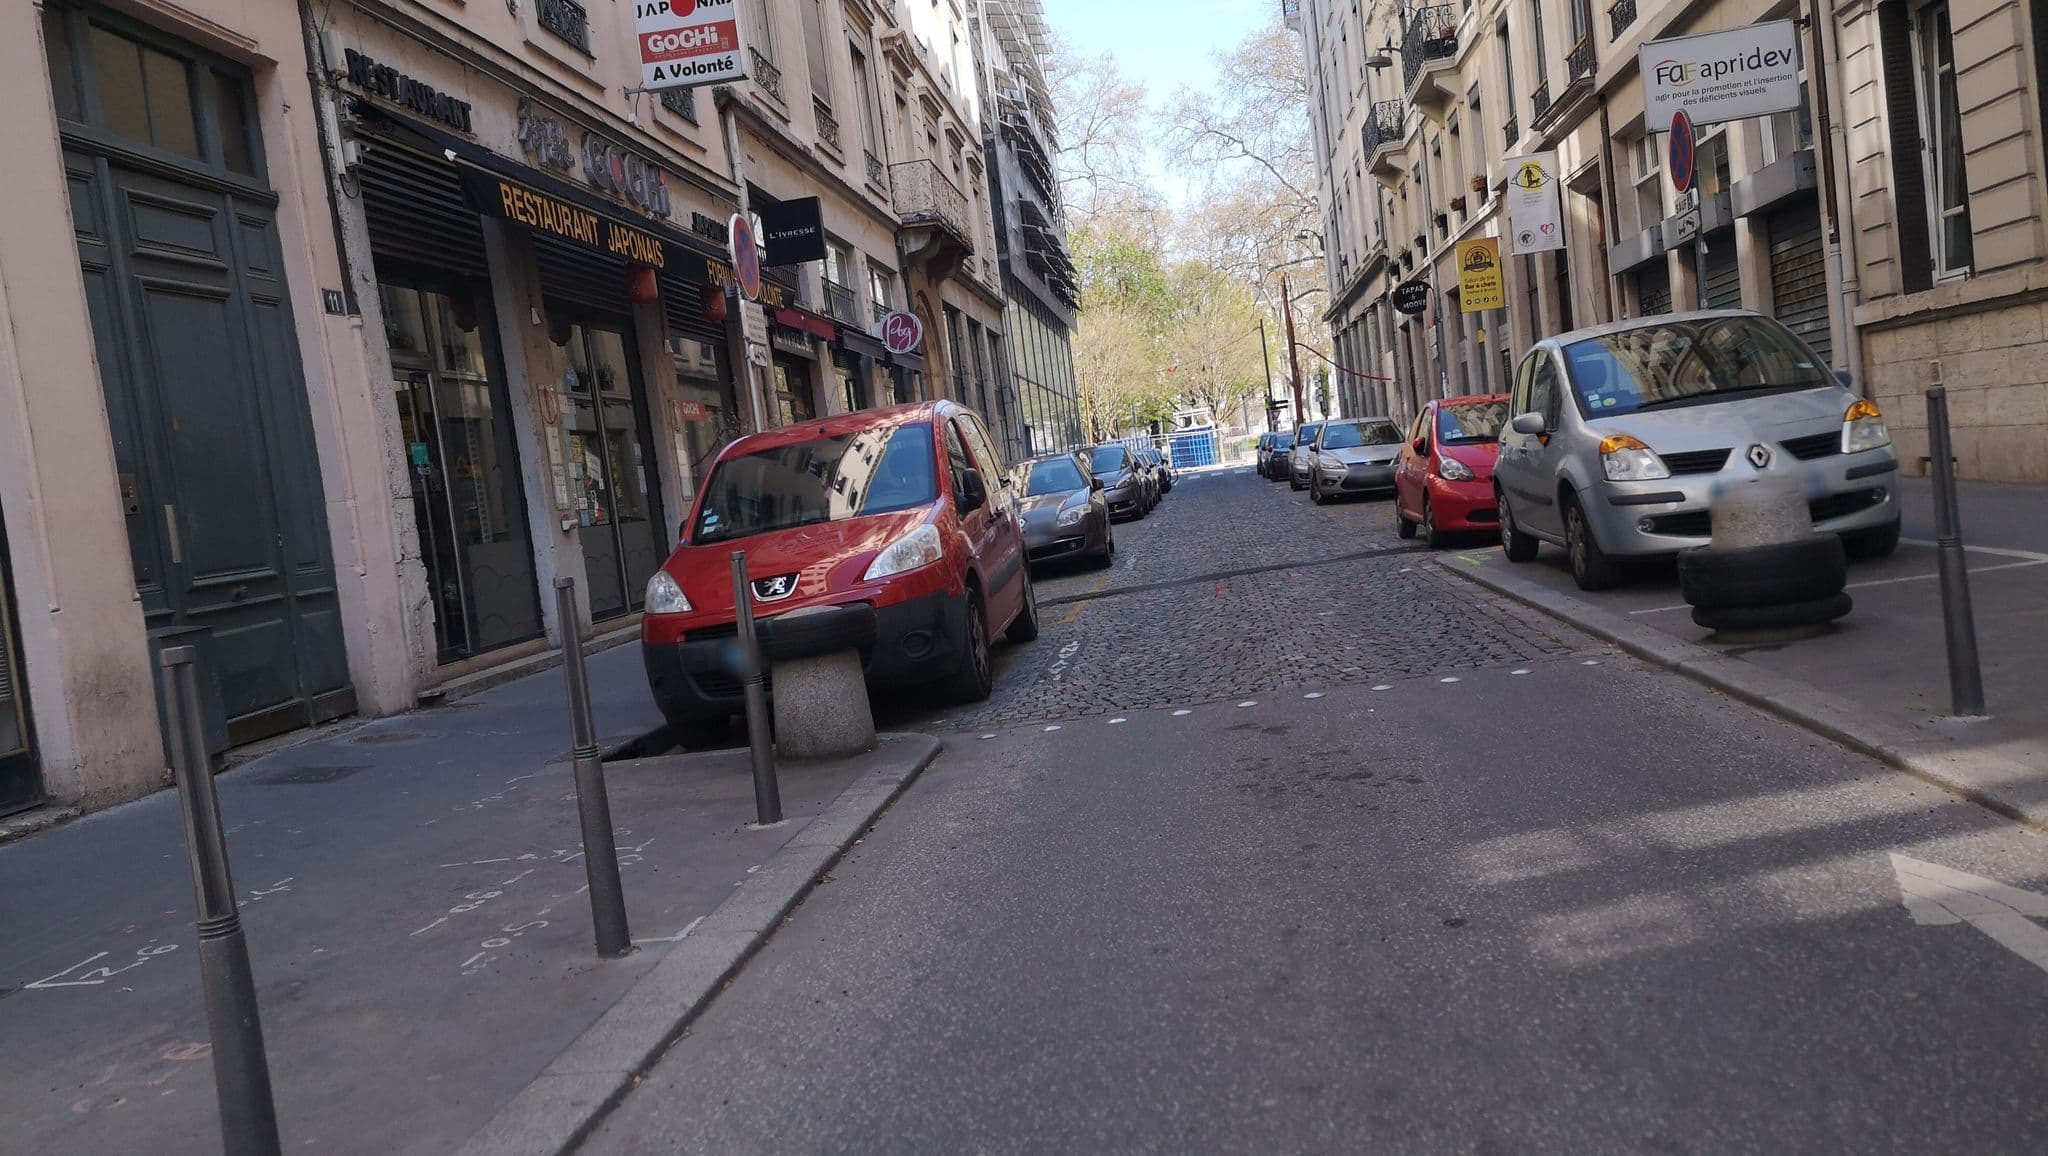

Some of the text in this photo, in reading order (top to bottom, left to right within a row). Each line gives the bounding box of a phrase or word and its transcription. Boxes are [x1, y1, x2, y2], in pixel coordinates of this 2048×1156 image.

[653, 55, 733, 81] A Volonté
[1700, 46, 1792, 80] apridev
[344, 48, 472, 133] RESTAURANT
[1655, 93, 1671, 102] agir
[1672, 90, 1690, 99] pour
[1701, 81, 1742, 95] promotion
[1753, 73, 1793, 85] l'insertion
[1699, 91, 1737, 103] déficients
[1739, 87, 1767, 97] visuels
[500, 183, 665, 269] RESTAURANT JAPONAIS
[769, 227, 816, 239] L'IVRESSE
[328, 292, 340, 312] 11
[1401, 285, 1424, 295] TAPAS
